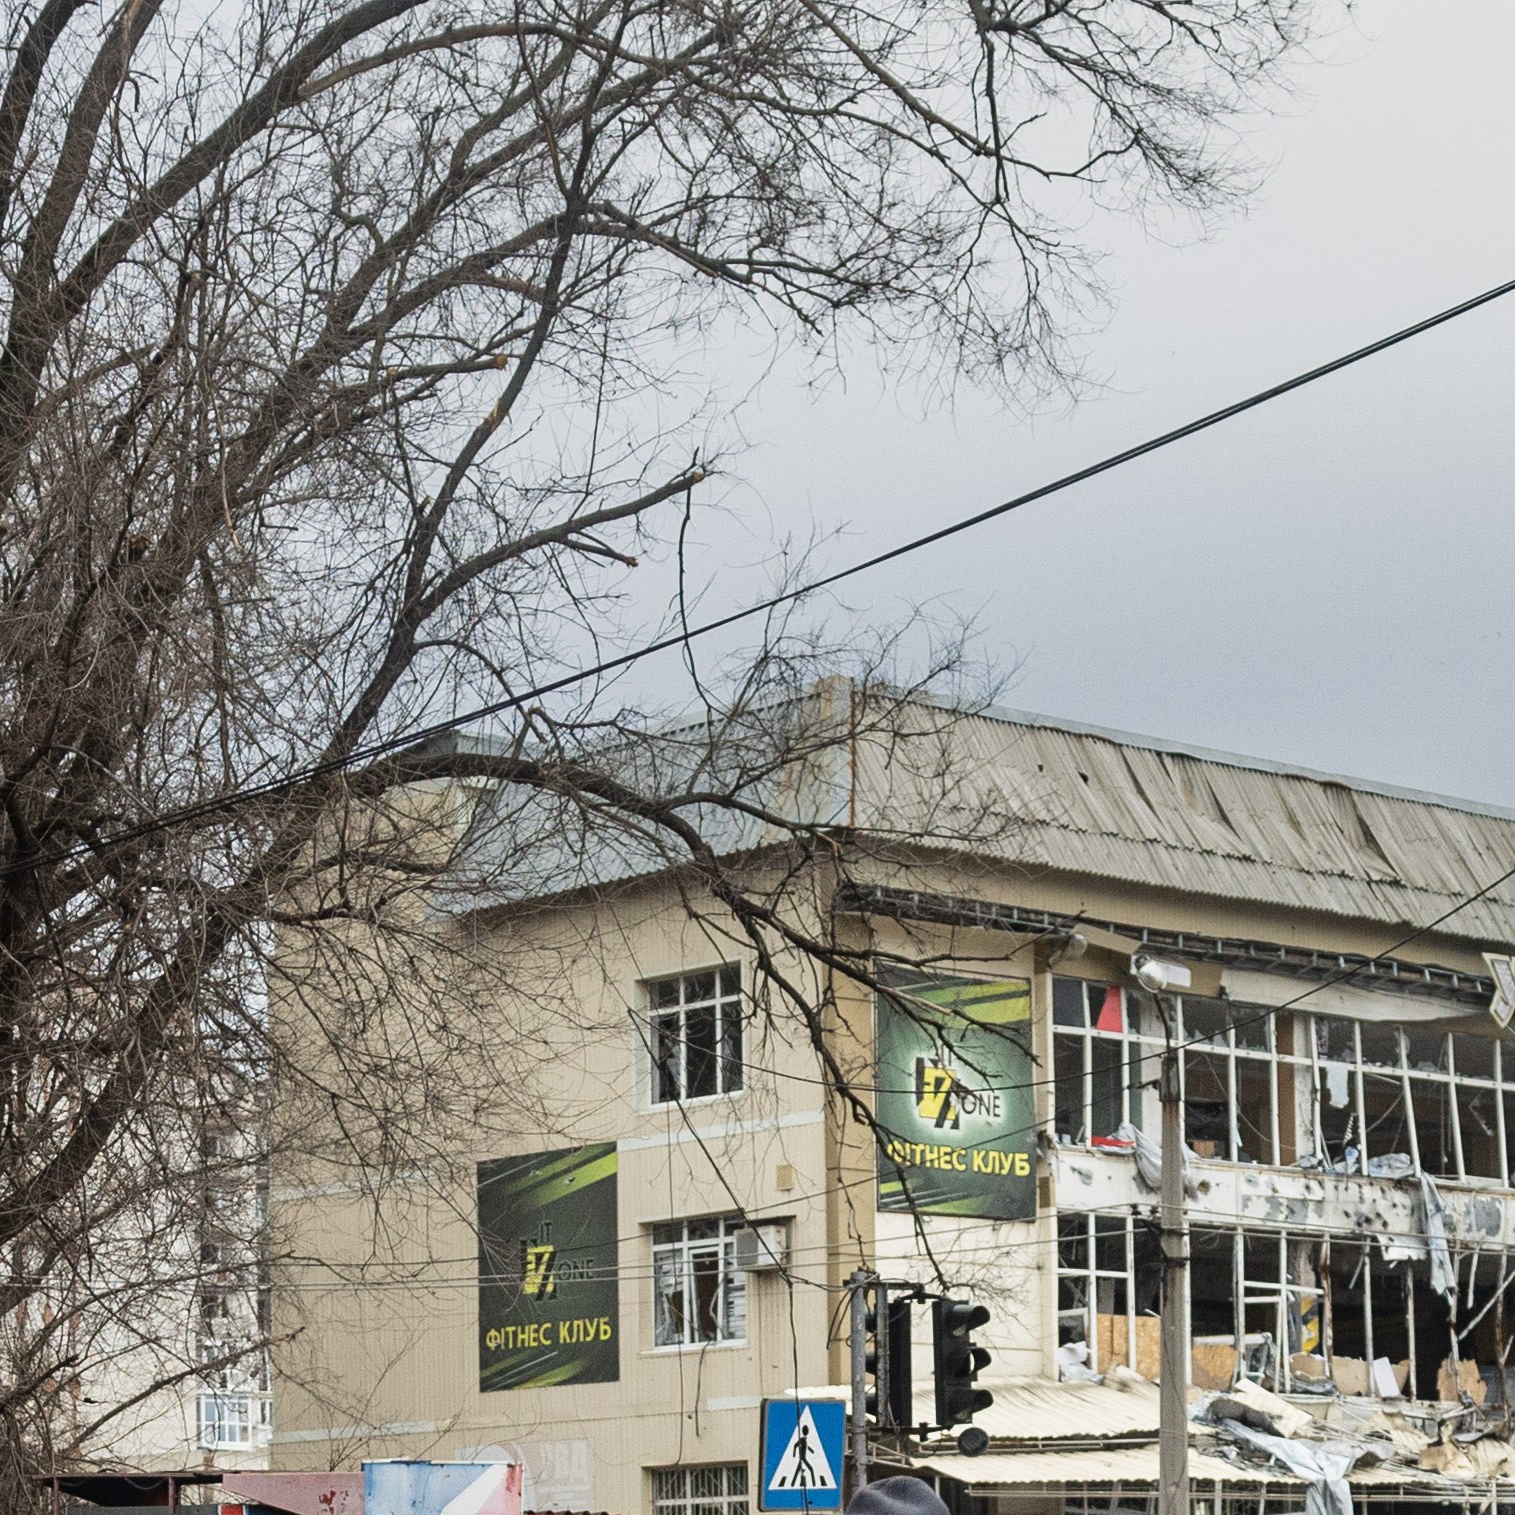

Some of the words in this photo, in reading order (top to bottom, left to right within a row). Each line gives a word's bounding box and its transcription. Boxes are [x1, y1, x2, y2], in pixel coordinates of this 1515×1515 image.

[887, 1140, 967, 1171] ФІТНЕС
[973, 1149, 1031, 1177] КЛУБ
[486, 1322, 552, 1350] ФІТНЕС
[559, 1316, 612, 1343] КЛУБ
